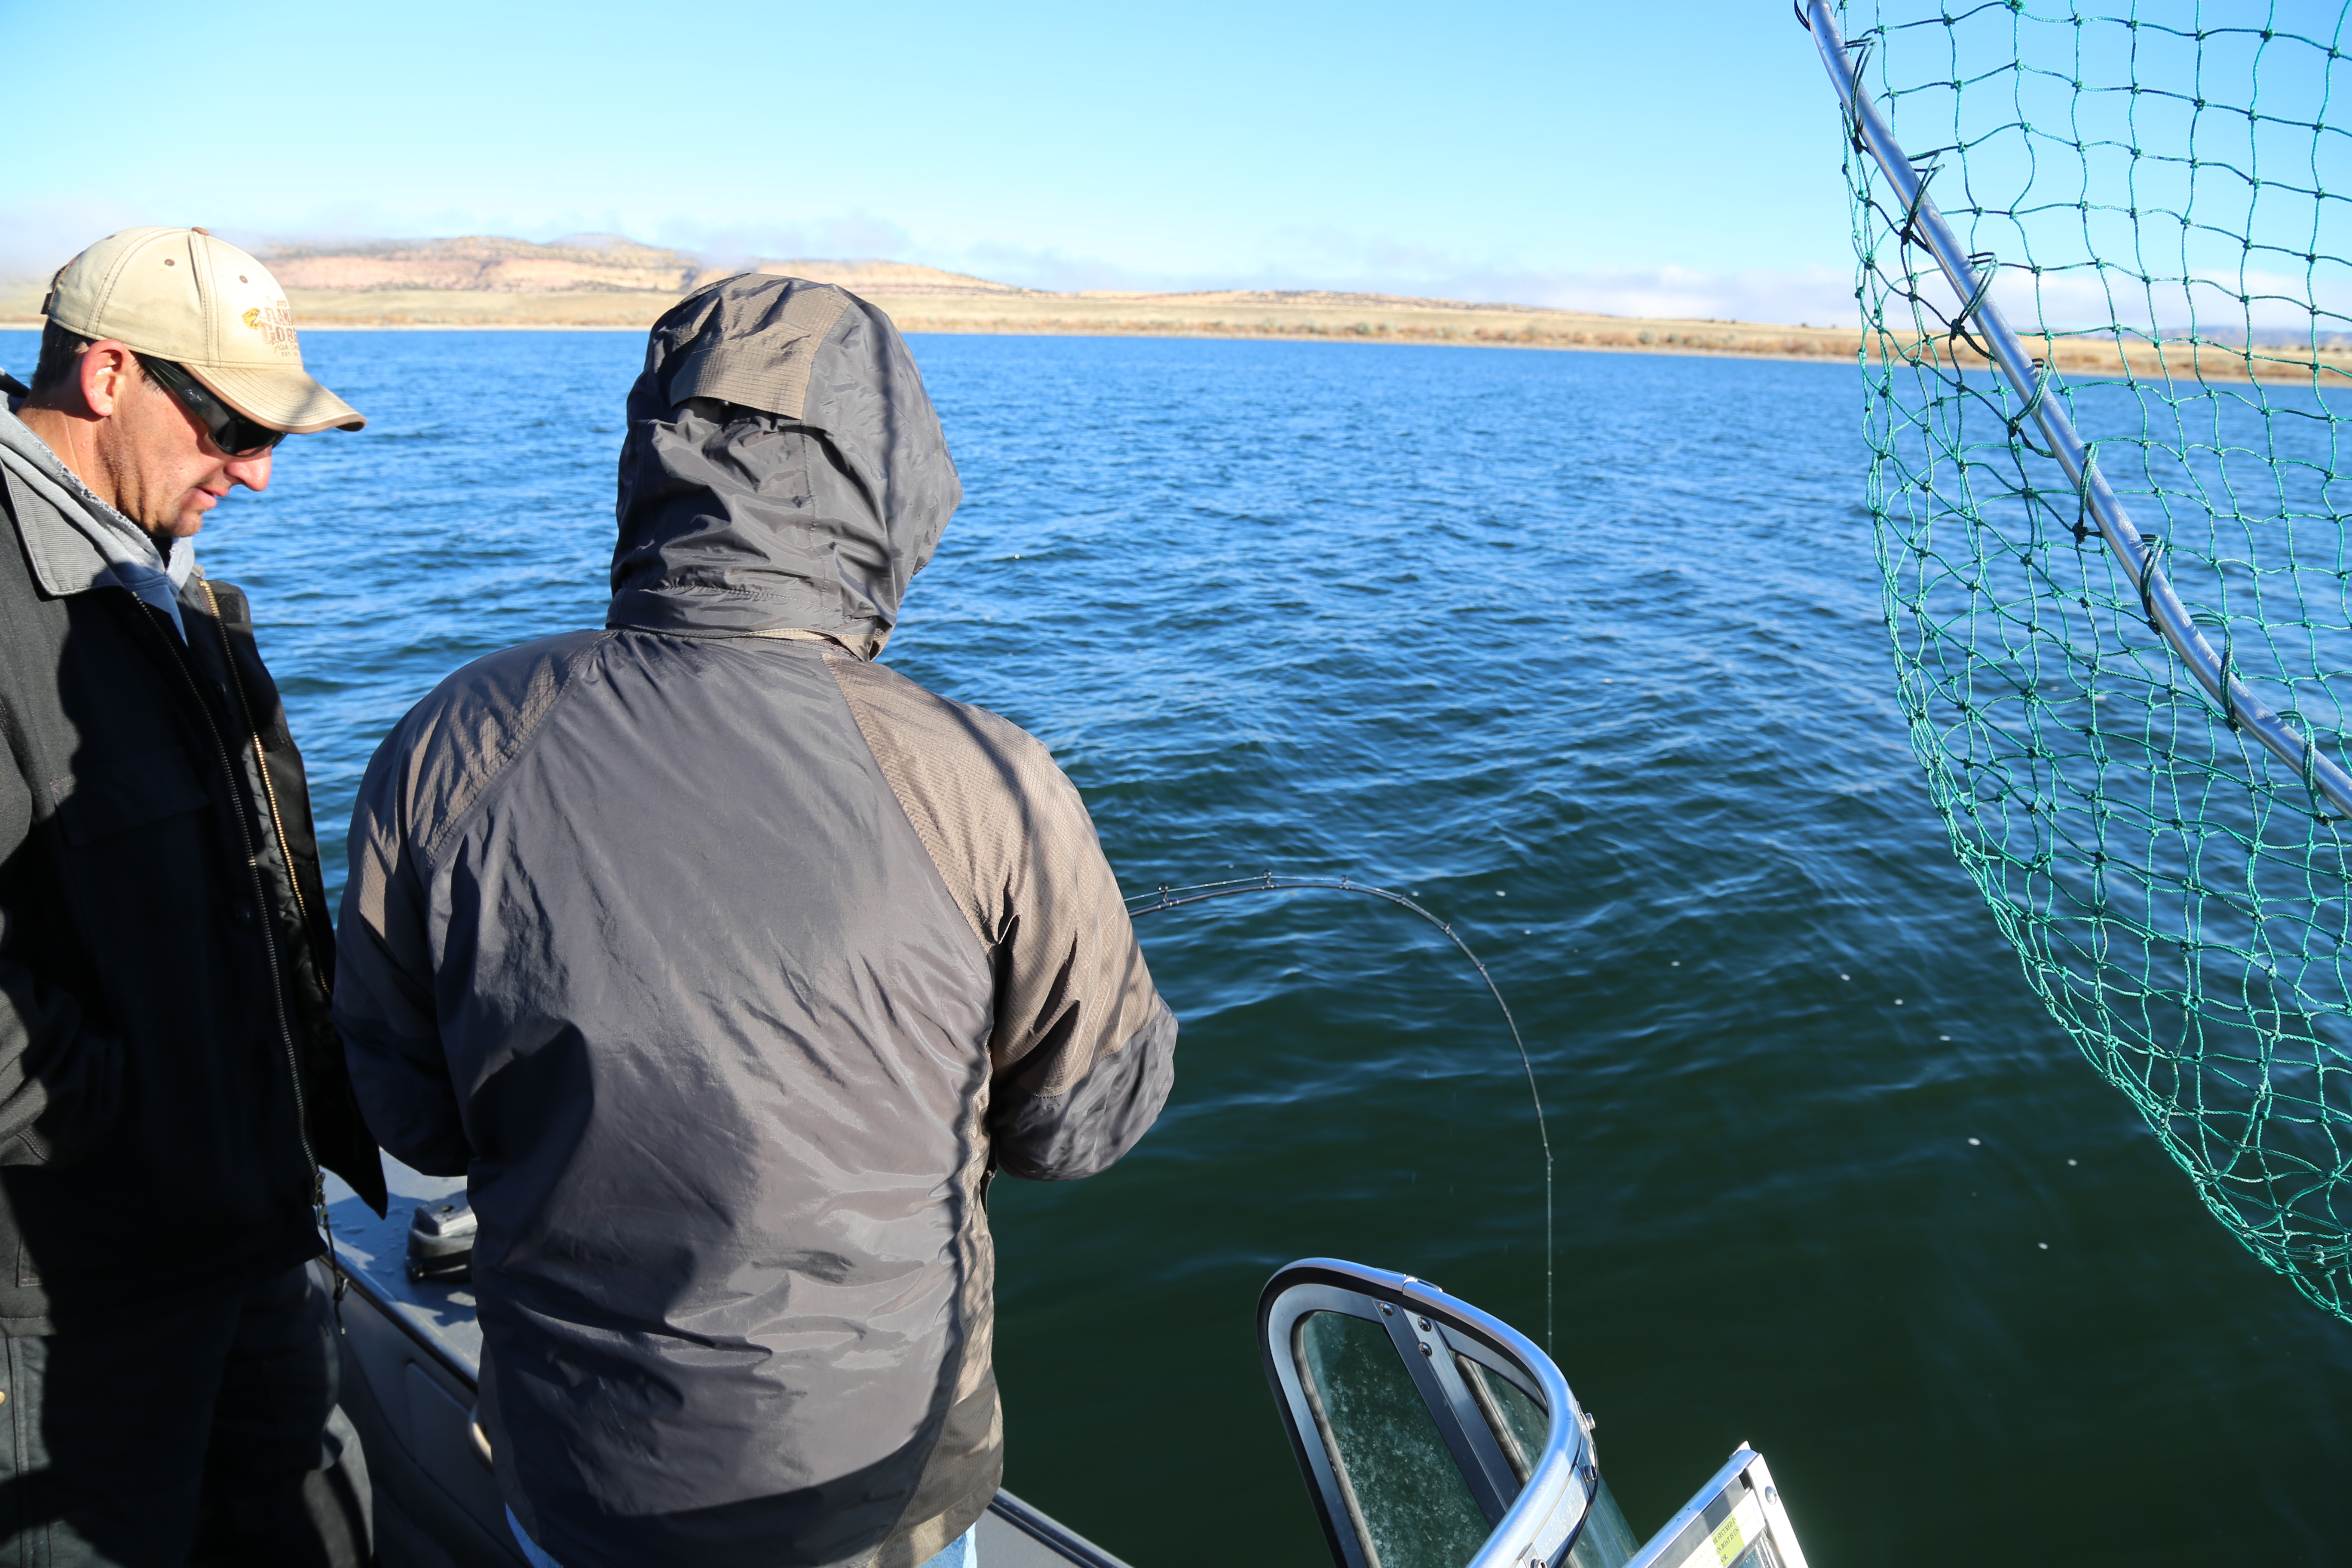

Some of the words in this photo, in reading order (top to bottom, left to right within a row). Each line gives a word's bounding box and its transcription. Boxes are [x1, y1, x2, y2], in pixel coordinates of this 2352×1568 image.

[272, 340, 289, 353] Fish
[1717, 1521, 1733, 1541] SECURED
[1720, 1536, 1731, 1551] BOAT
[1730, 1532, 1735, 1540] IS
